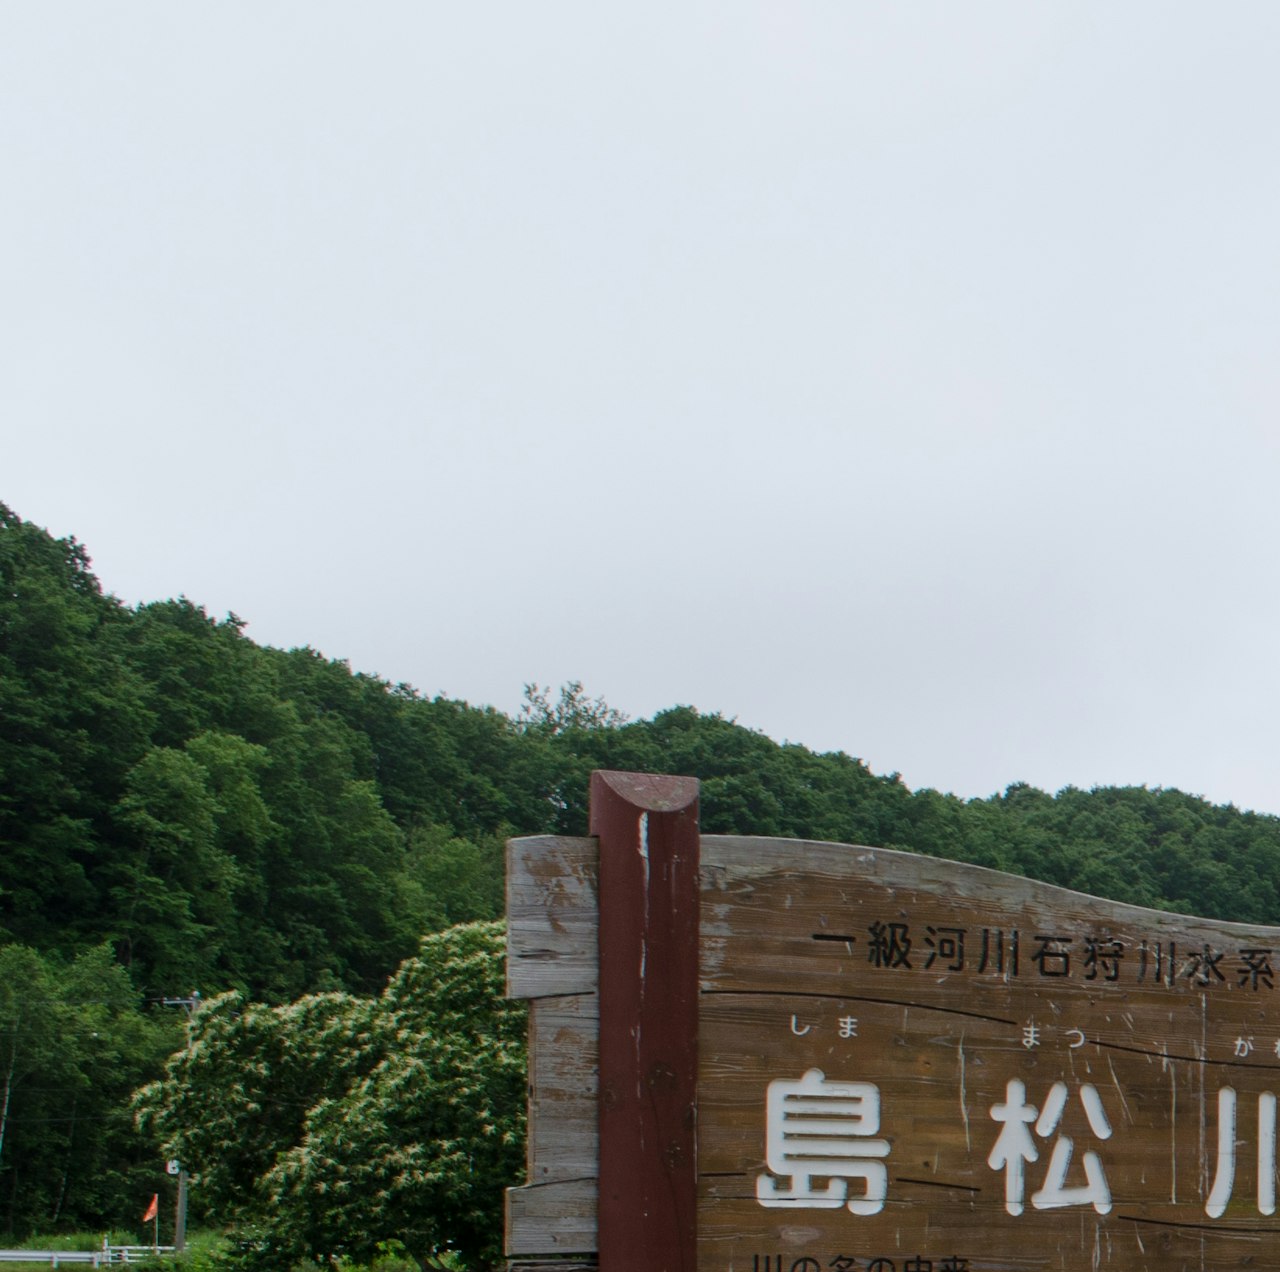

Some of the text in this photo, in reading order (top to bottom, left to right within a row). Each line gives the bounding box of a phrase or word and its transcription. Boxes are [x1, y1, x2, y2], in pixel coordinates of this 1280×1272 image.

[811, 920, 1275, 991] 一級河川石狩川水系
[790, 1014, 859, 1038] しま
[1021, 1021, 1086, 1050] まつ
